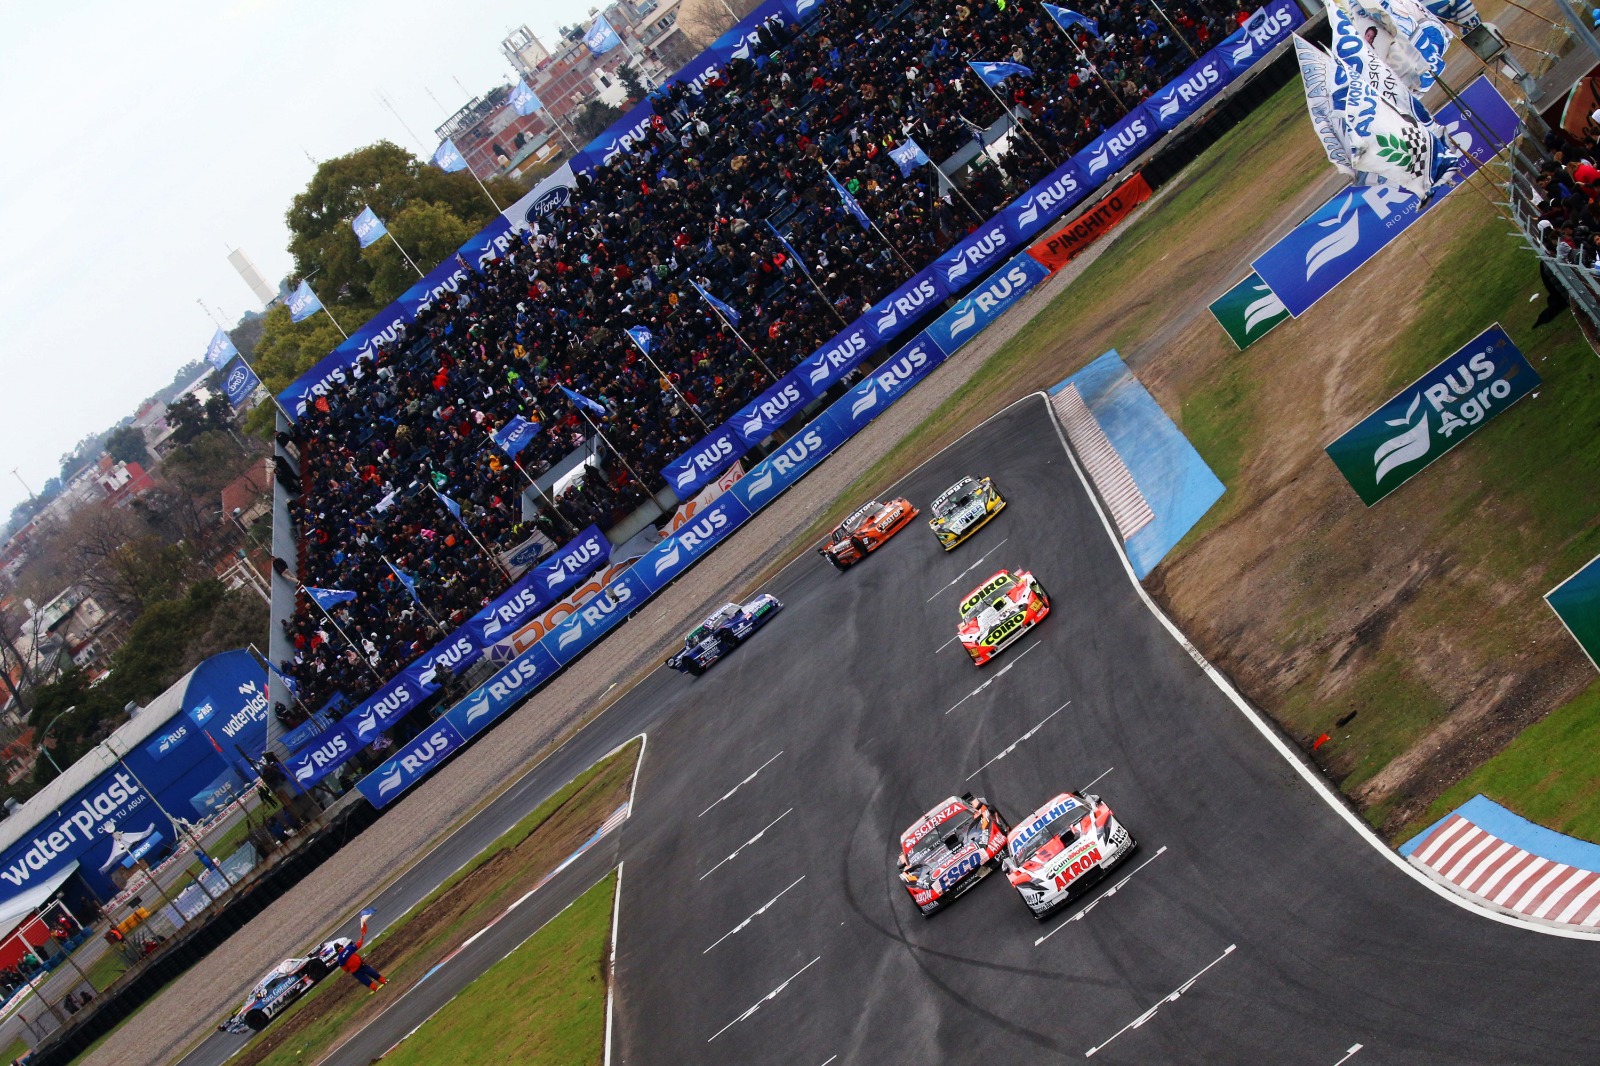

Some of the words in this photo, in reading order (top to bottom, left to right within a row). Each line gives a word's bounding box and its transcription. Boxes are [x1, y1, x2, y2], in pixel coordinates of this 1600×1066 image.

[1177, 64, 1219, 102] RUS
[1106, 119, 1147, 157] RUS
[535, 192, 562, 217] Ford
[1036, 173, 1077, 211] RUS
[1046, 196, 1123, 255] PINCHITO
[1385, 213, 1402, 229] RIO
[966, 227, 1006, 265] RUS
[895, 280, 935, 316] RUS
[974, 266, 1027, 314] RUS
[827, 332, 866, 368] RUS
[876, 344, 928, 393] RUS
[1424, 351, 1495, 412] RUS
[760, 384, 800, 420] RUS
[1437, 379, 1511, 438] Agro
[694, 437, 733, 473] RUS
[771, 430, 822, 476] RUS
[679, 509, 728, 551] RUS
[563, 537, 600, 573] RUS
[499, 588, 536, 623] RUS
[961, 576, 1008, 615] COIRO
[985, 613, 1025, 646] COIRO
[488, 654, 537, 701] RUS
[202, 702, 213, 718] RUS
[222, 690, 268, 738] waterplast
[373, 684, 410, 720] RUS
[168, 726, 187, 744] RUS
[401, 731, 449, 774] RUS
[311, 738, 347, 772] RUS
[114, 808, 127, 819] TU
[125, 793, 147, 811] AGUA
[213, 781, 232, 801] RUS
[1, 772, 139, 886] waterplast
[914, 804, 962, 838] SCIENZA
[1012, 799, 1076, 851] ALLOCHIS
[138, 841, 150, 855] RUS
[939, 852, 981, 891] ESCO
[1054, 848, 1102, 892] AKRON
